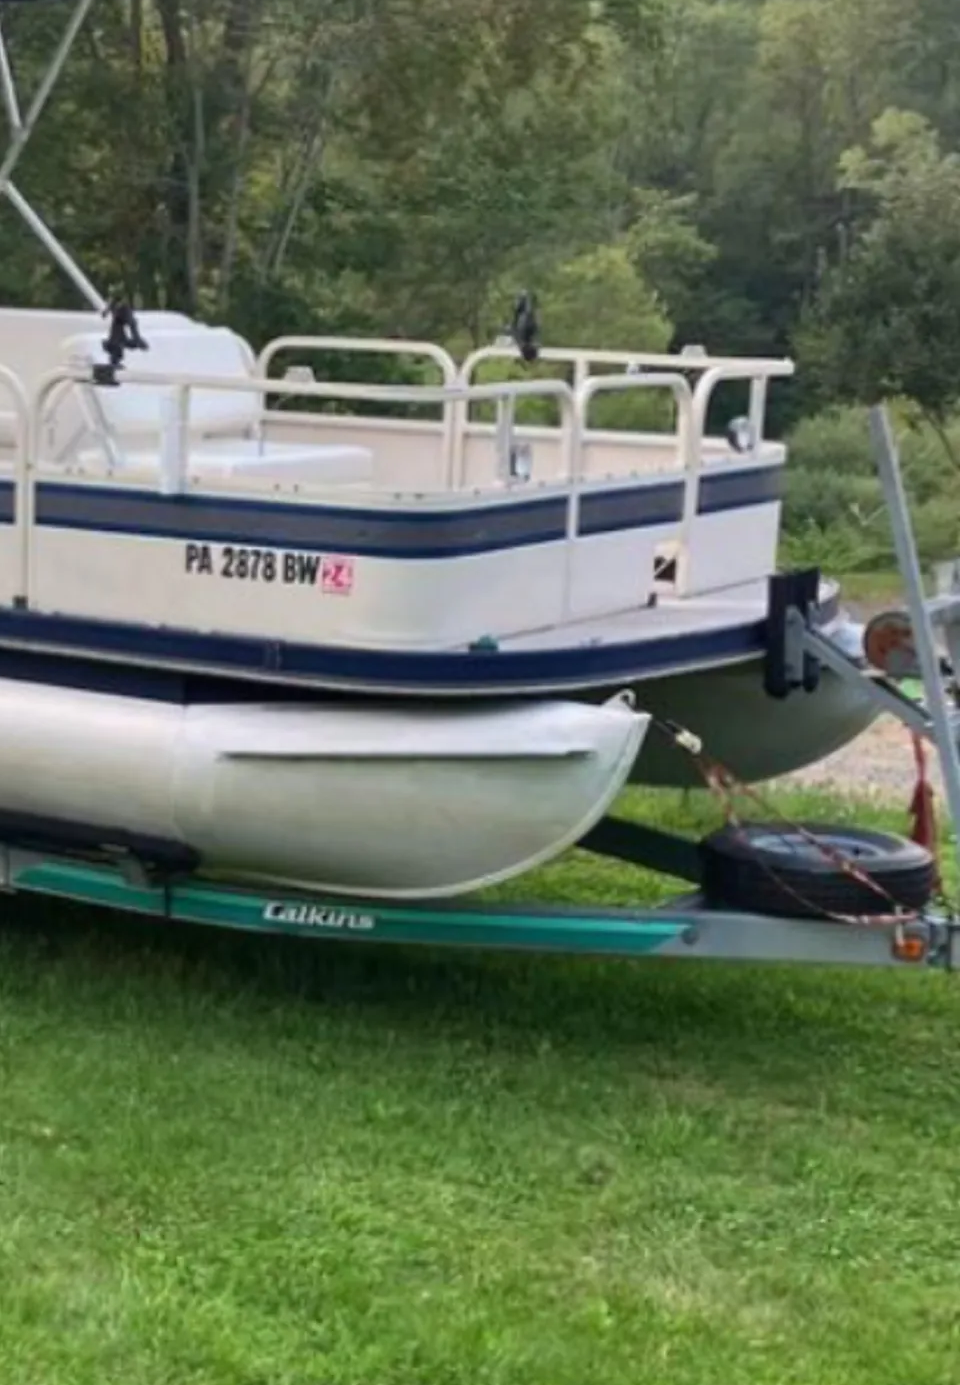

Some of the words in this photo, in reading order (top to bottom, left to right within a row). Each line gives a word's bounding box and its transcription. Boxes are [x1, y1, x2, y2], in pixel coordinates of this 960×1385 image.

[185, 544, 212, 575] PA
[221, 547, 276, 582] 2878
[283, 553, 320, 585] BW
[262, 902, 376, 929] Calkins
